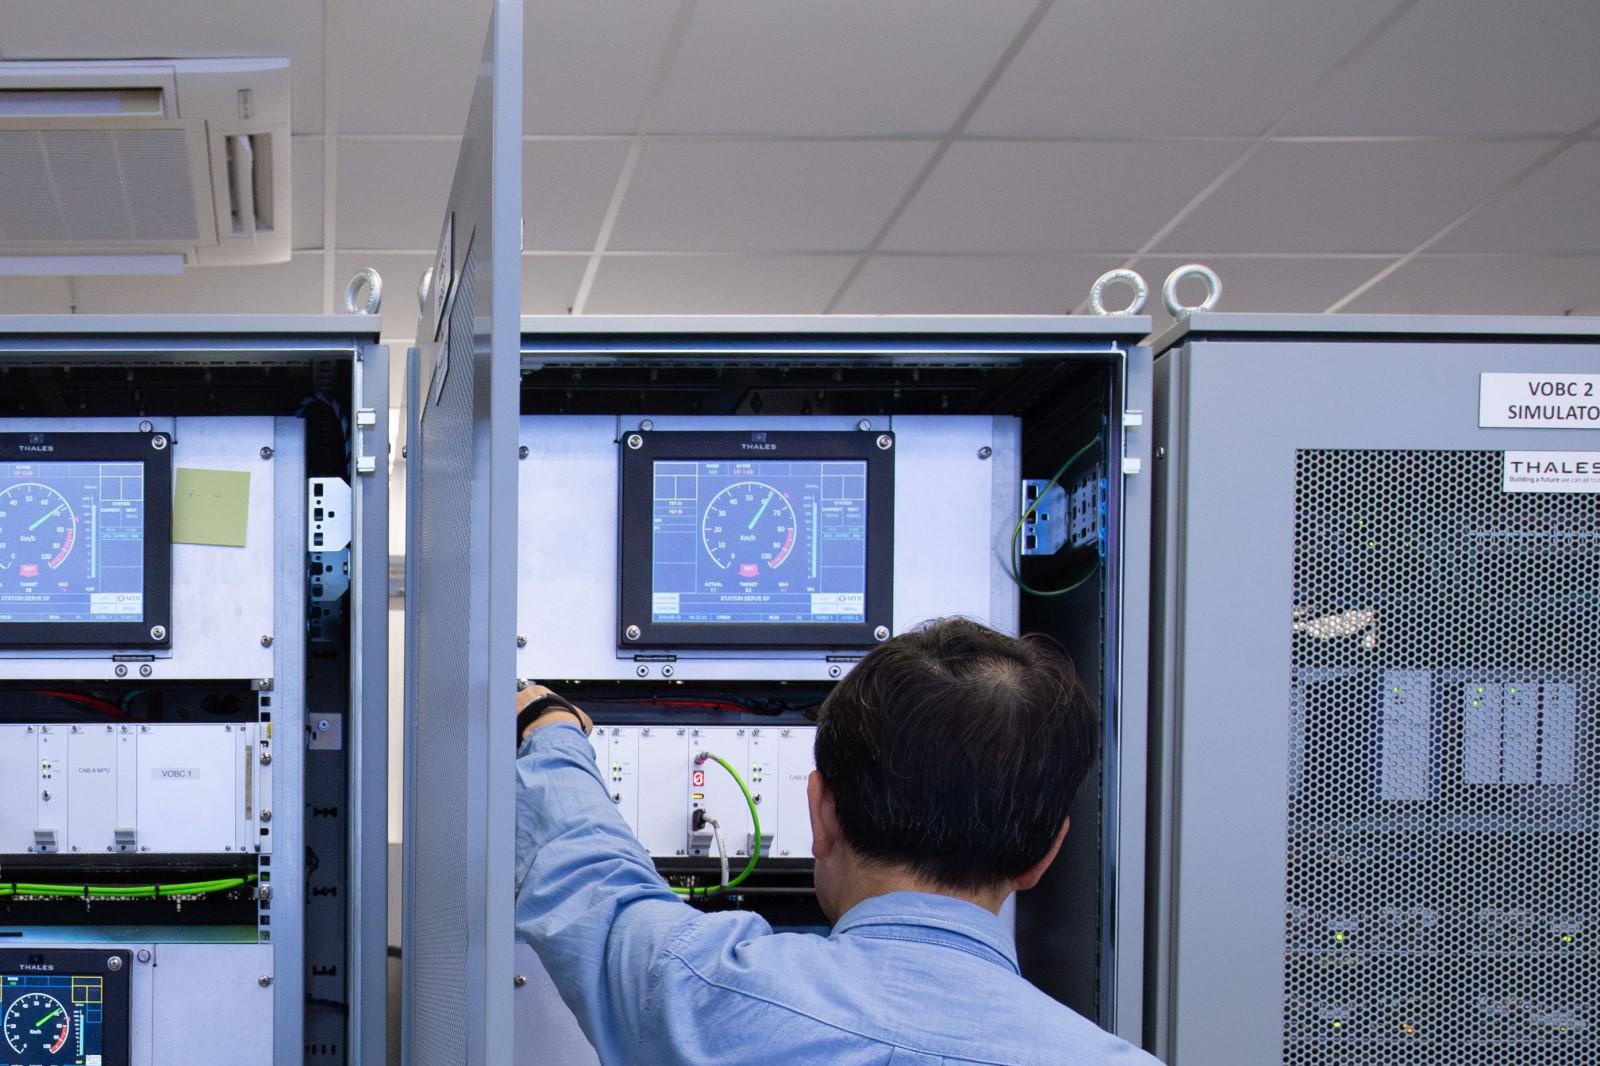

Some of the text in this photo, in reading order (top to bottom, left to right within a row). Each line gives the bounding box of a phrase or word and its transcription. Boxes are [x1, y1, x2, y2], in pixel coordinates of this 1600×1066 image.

[1528, 382, 1593, 397] VOBC 2
[1508, 405, 1600, 420] SIMULATO
[1510, 462, 1600, 473] THALES
